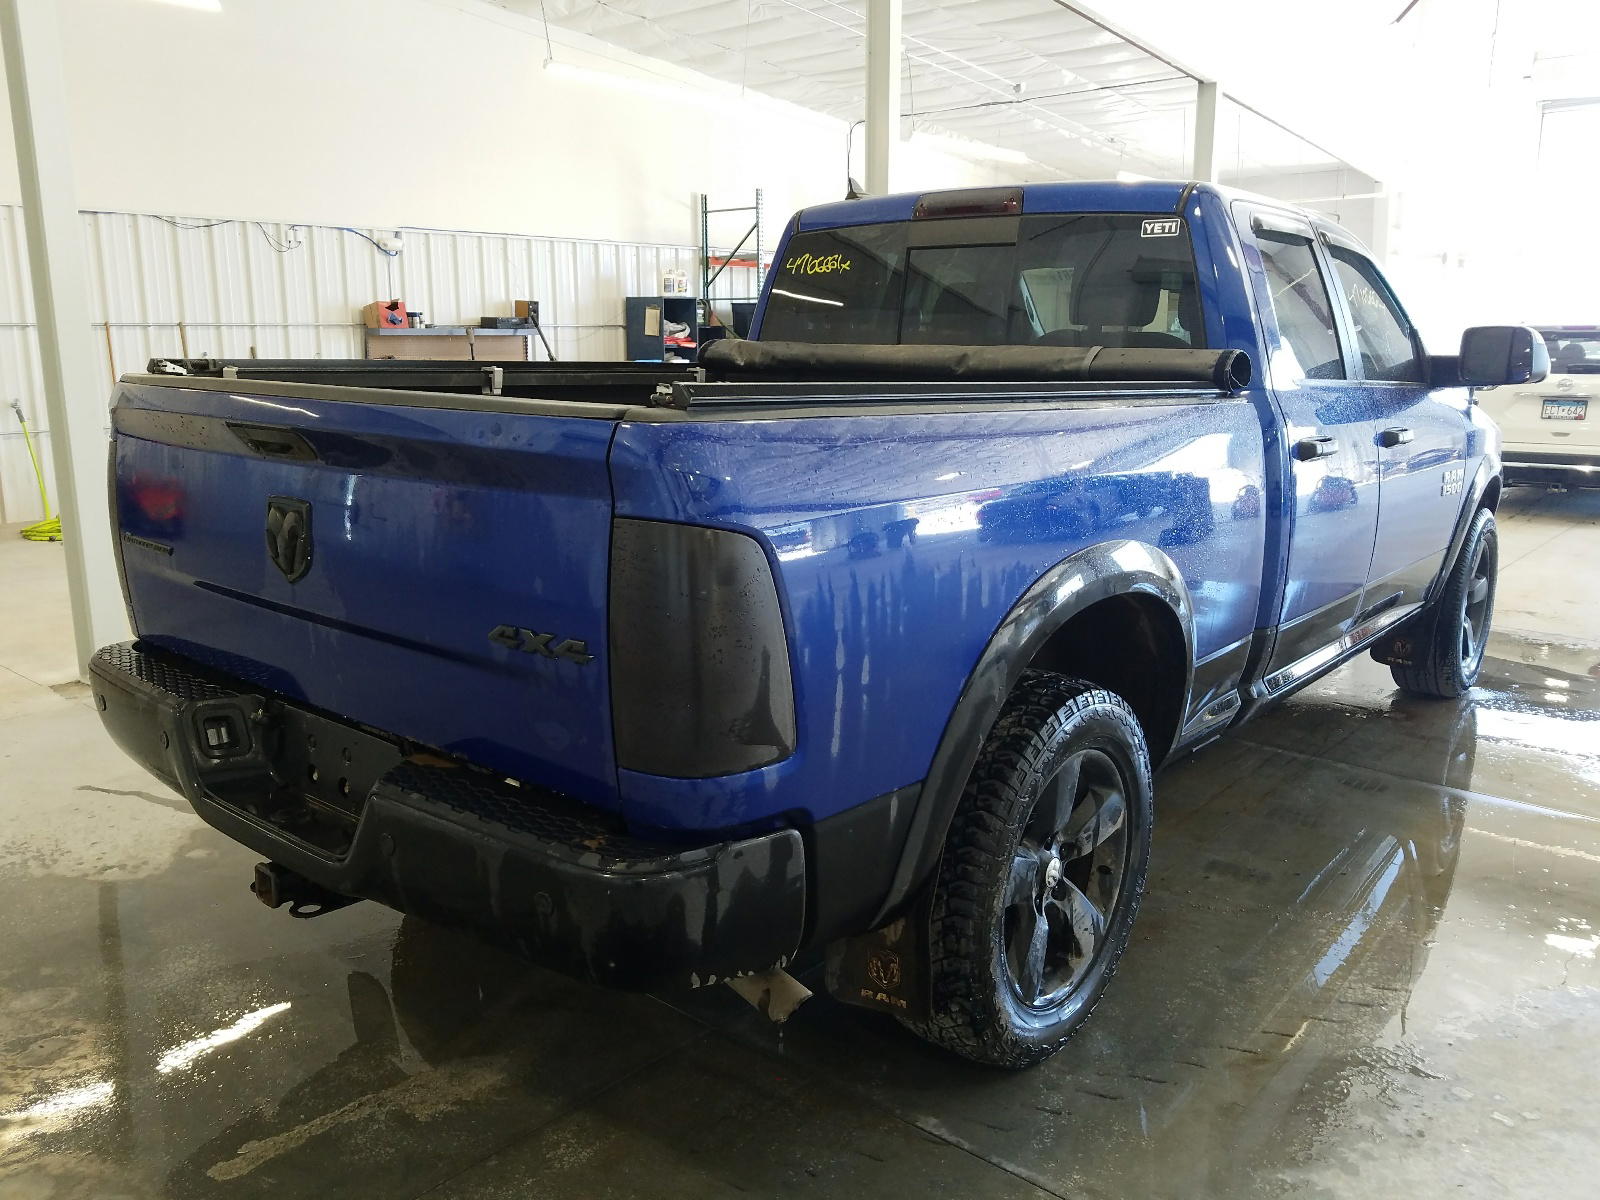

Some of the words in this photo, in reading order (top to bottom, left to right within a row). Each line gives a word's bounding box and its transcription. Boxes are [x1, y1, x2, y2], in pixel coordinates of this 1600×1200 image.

[1144, 221, 1178, 234] YETI
[1442, 468, 1465, 484] RAM
[860, 988, 907, 1009] RAM
